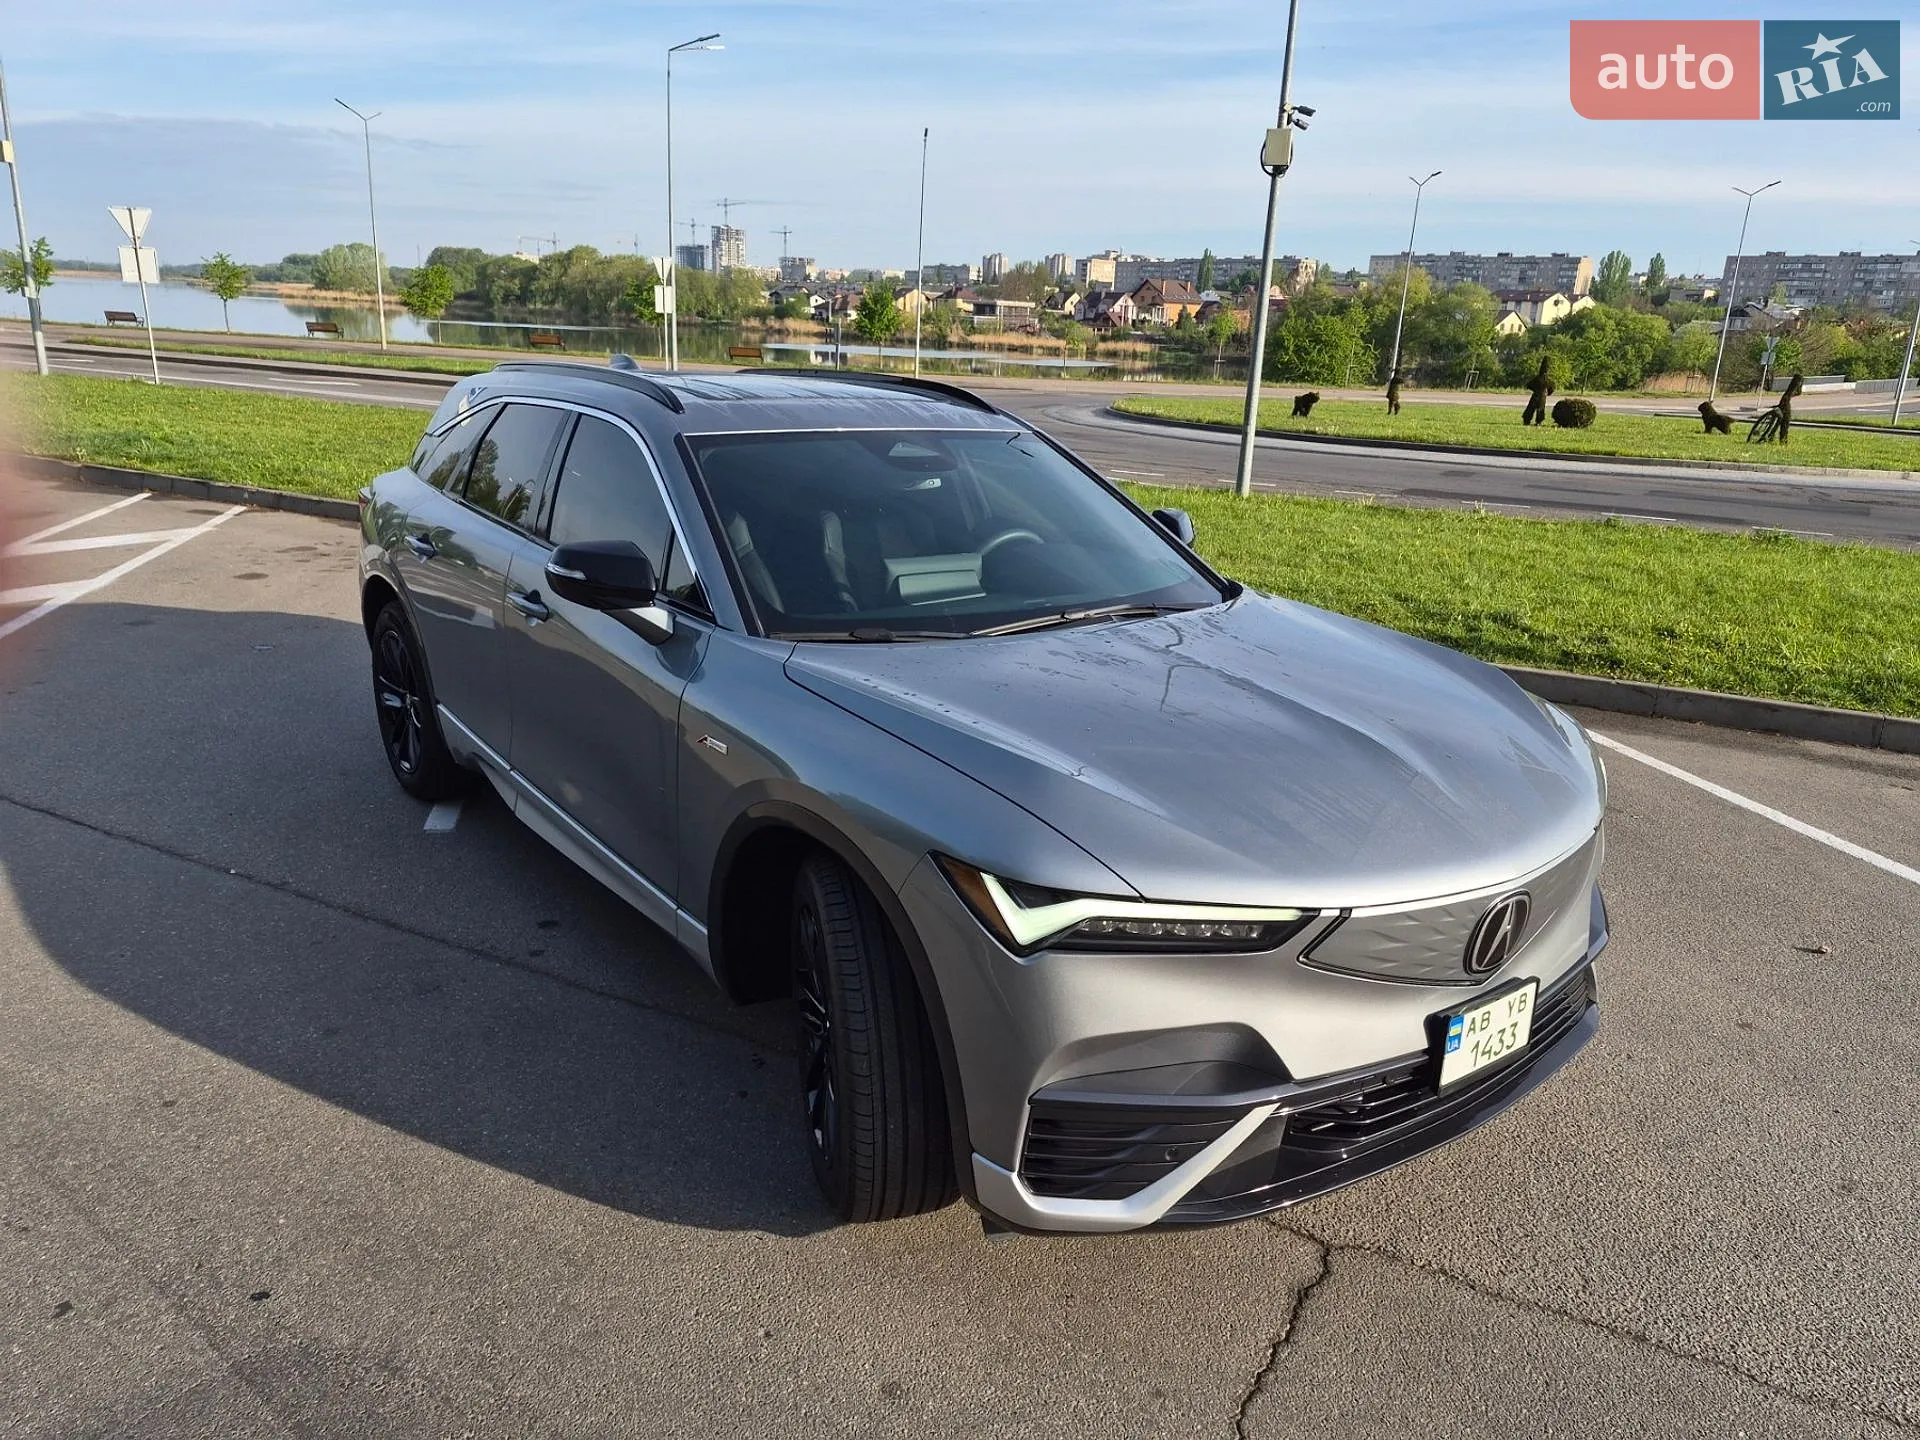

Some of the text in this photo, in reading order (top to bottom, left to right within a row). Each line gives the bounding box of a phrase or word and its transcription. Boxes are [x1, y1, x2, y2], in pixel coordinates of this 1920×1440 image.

[1466, 991, 1528, 1038] AB YB
[1470, 1020, 1519, 1068] 1433
